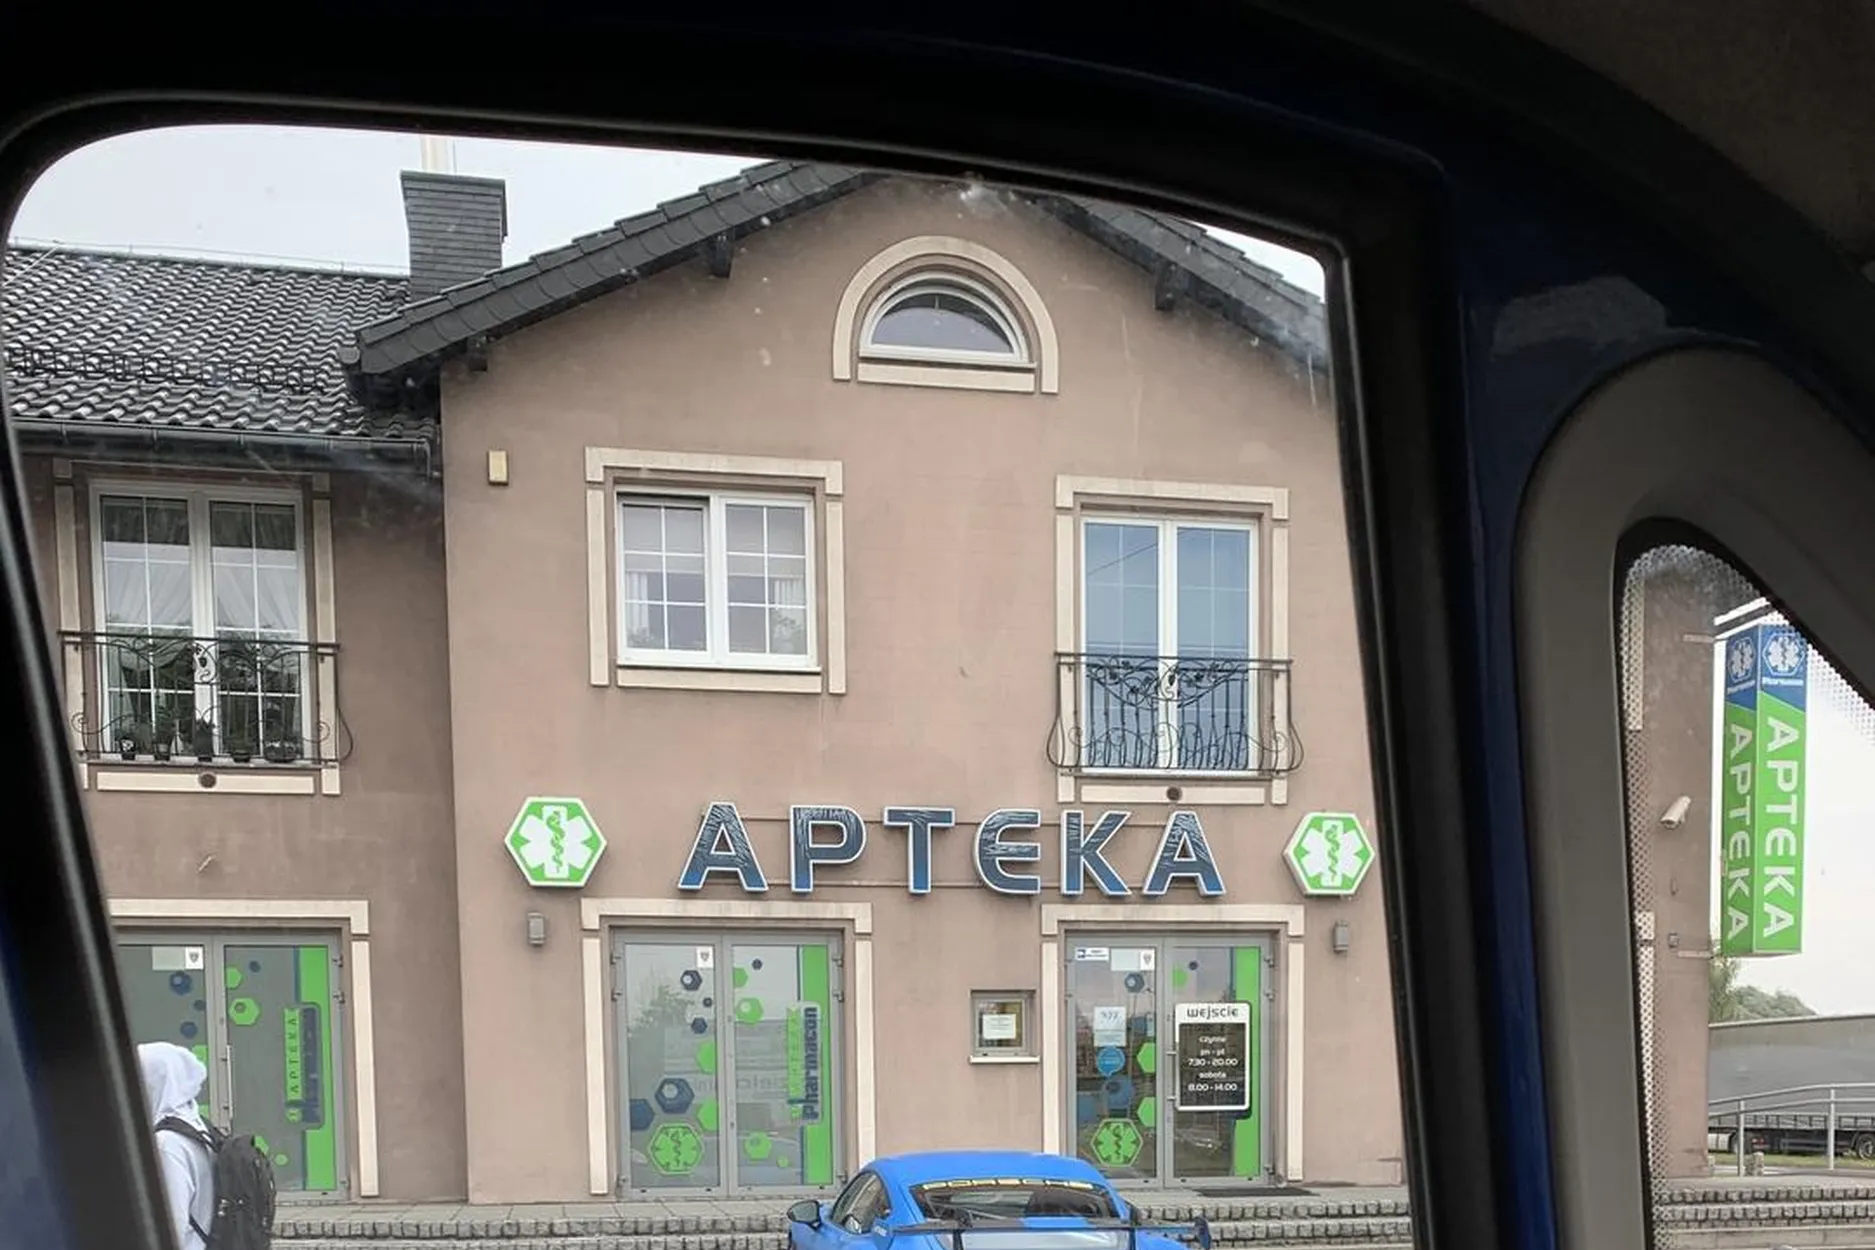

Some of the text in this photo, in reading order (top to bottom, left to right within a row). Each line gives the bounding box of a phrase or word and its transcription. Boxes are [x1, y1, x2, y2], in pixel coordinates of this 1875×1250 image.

[678, 802, 1226, 895] APTEKA
[1728, 723, 1752, 940] APTEKA
[1763, 716, 1800, 938] APTEKA
